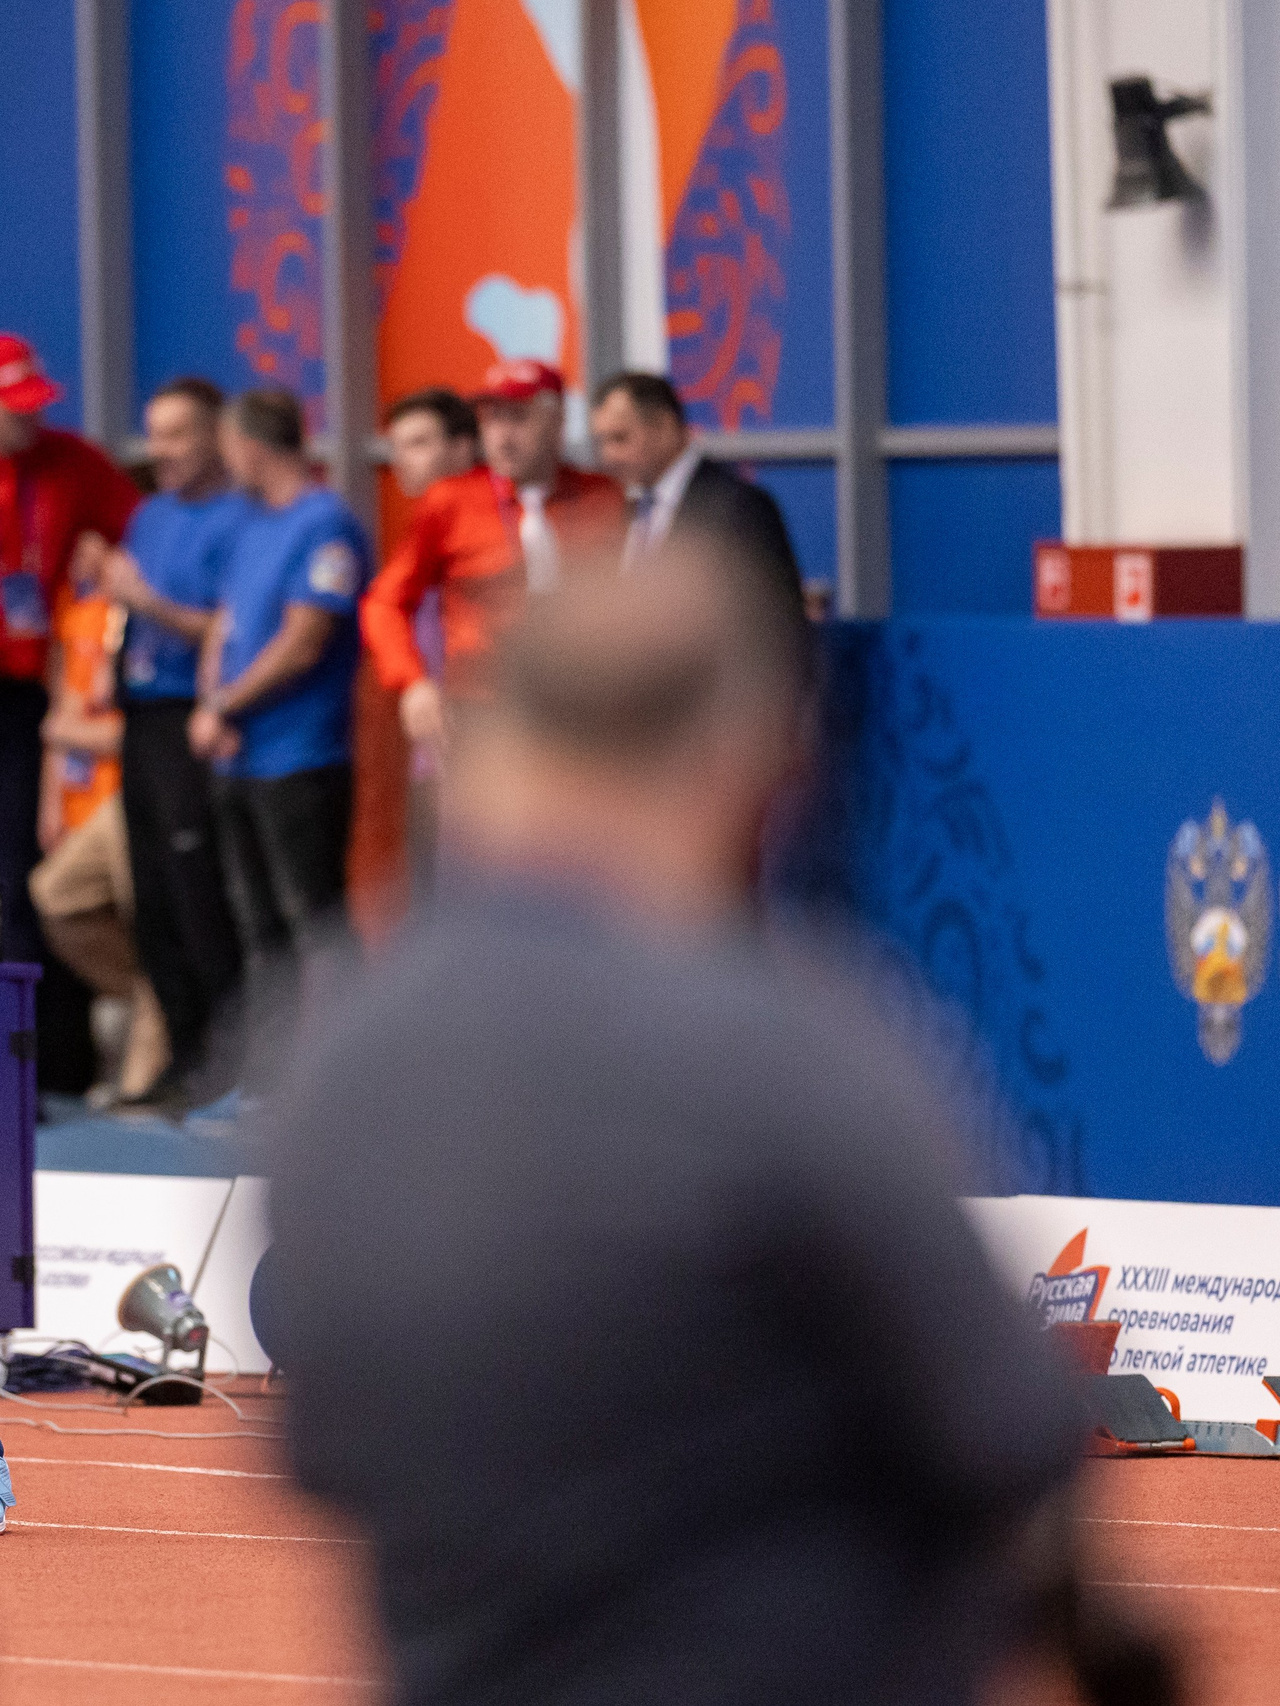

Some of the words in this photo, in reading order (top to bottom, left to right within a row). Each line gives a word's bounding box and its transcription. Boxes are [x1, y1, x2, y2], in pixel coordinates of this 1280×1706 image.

[1027, 1272, 1097, 1309] Русская
[1107, 1307, 1236, 1335] соревнования
[1120, 1345, 1185, 1372] легкой
[1186, 1353, 1269, 1377] атлетике
